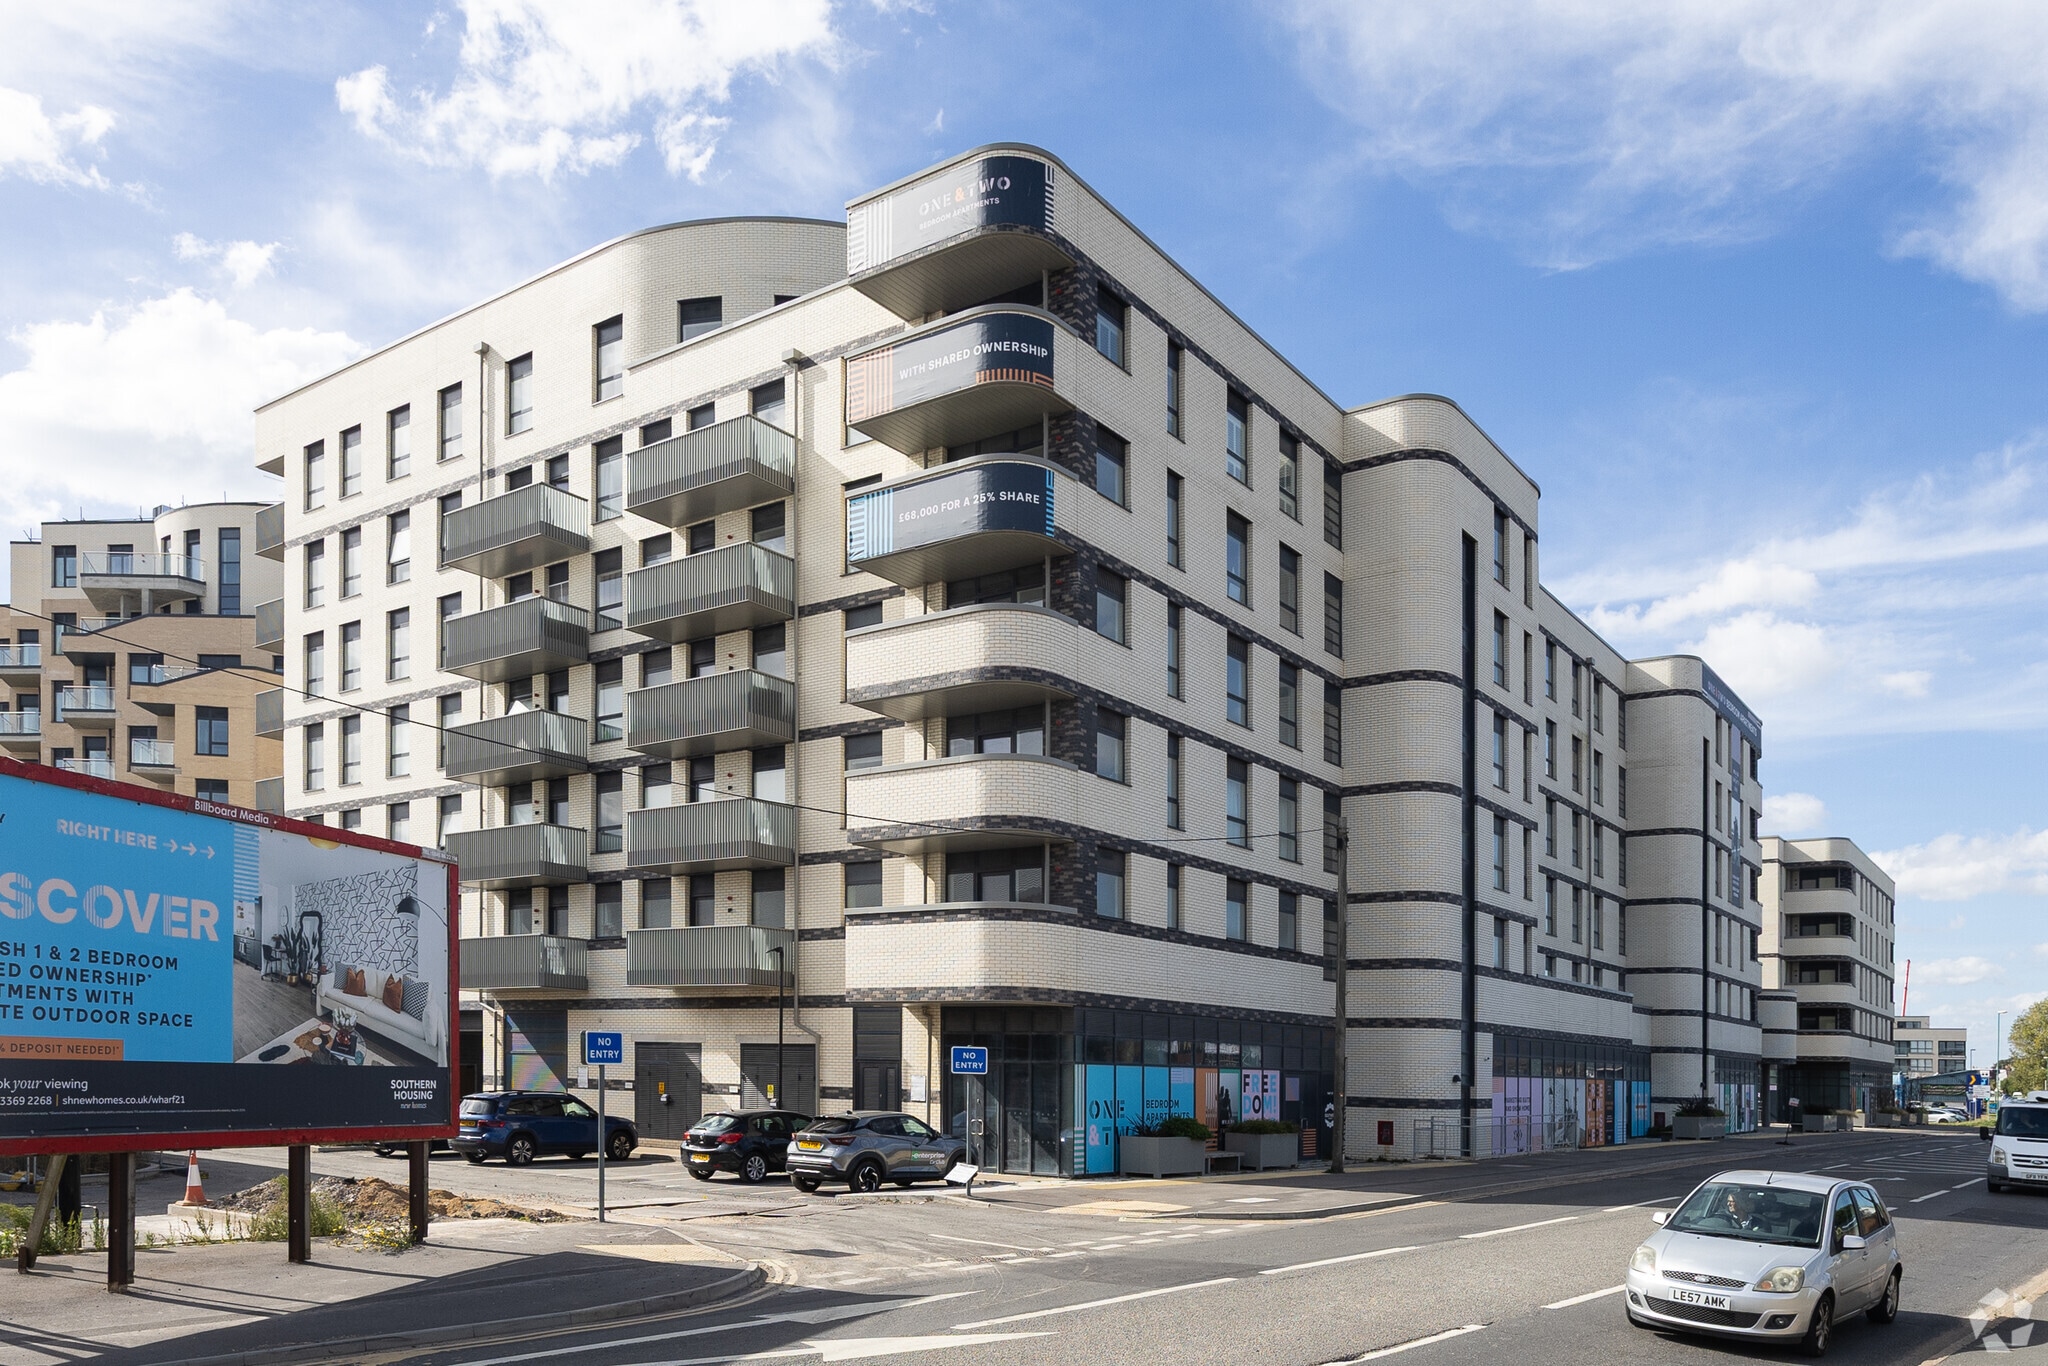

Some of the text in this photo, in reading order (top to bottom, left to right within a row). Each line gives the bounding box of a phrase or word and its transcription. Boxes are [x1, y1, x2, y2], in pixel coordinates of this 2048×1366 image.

[955, 187, 966, 202] &
[966, 176, 1011, 198] TWO
[952, 197, 1000, 217] APARTMENTS
[899, 341, 1048, 380] WITH SHARED OWNERSHIP
[898, 491, 1040, 523] £68,000 FOR A 25% SHARE
[194, 800, 269, 824] Billboard Media
[56, 818, 157, 850] RIGHT HERE
[34, 944, 41, 958] 1
[50, 945, 62, 960] &
[70, 948, 80, 962] 2
[88, 949, 178, 970] BEDROOM
[85, 989, 134, 1005] WITH
[32, 1006, 130, 1024] OUTDOOR
[137, 1012, 193, 1027] SPACE
[10, 1043, 63, 1053] DEPOSIT
[597, 1037, 612, 1046] NO
[590, 1050, 620, 1059] ENTRY
[955, 1061, 984, 1069] ENTRY
[11, 1079, 43, 1093] your
[44, 1078, 89, 1091] viewing
[390, 1079, 437, 1089] SOUTHERN
[1243, 1074, 1277, 1093] FREE
[27, 1096, 52, 1105] 2268
[62, 1095, 186, 1105] shnewhomes.co.uk/wharf21
[393, 1090, 433, 1100] HOUSING
[1146, 1099, 1180, 1108] BEDROOM
[1089, 1100, 1125, 1119] ONE
[1089, 1124, 1100, 1146] &
[912, 1152, 945, 1160] enterprise
[1673, 1290, 1726, 1308] LE57 AMK
